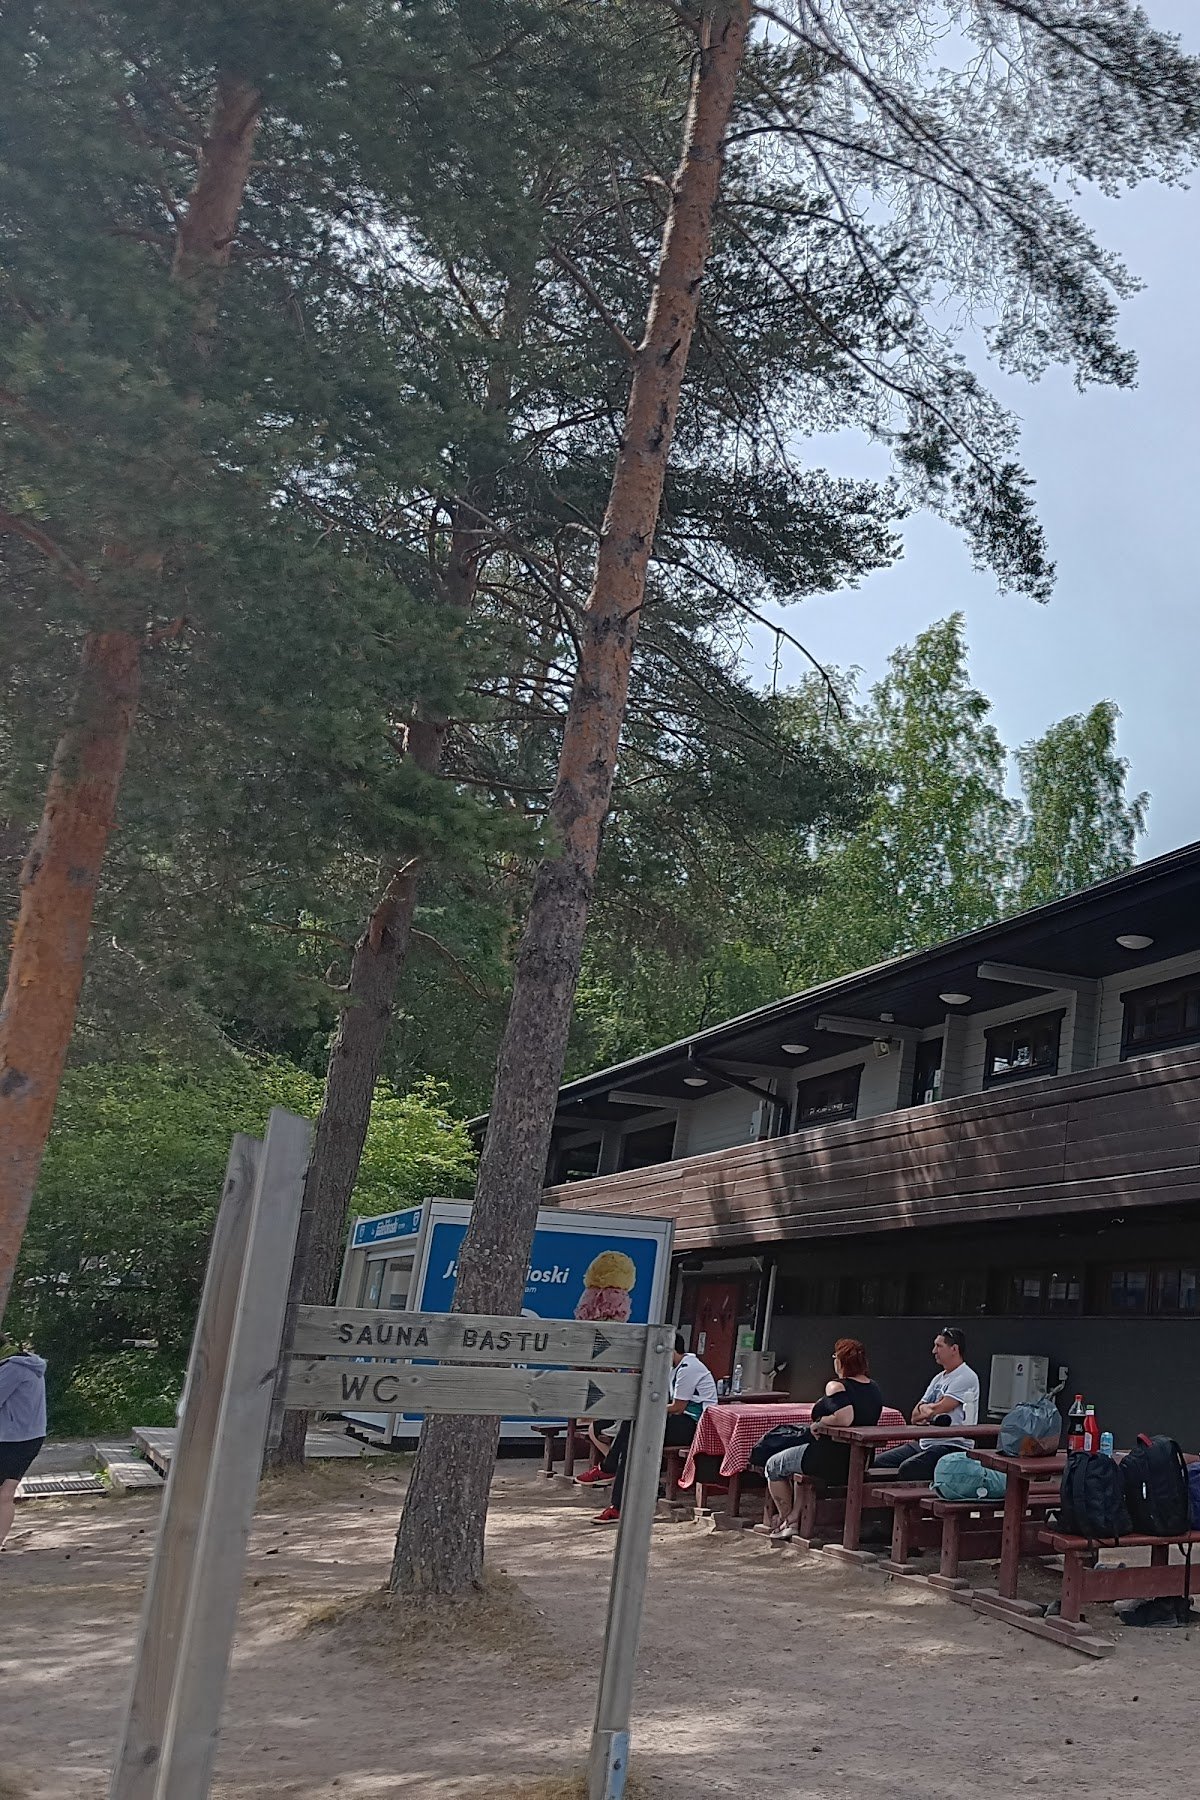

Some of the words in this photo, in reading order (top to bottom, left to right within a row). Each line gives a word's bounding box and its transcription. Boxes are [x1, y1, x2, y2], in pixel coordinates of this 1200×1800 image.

[338, 1323, 429, 1348] SAUNA
[462, 1329, 549, 1353] BASTU
[341, 1373, 400, 1403] WC
